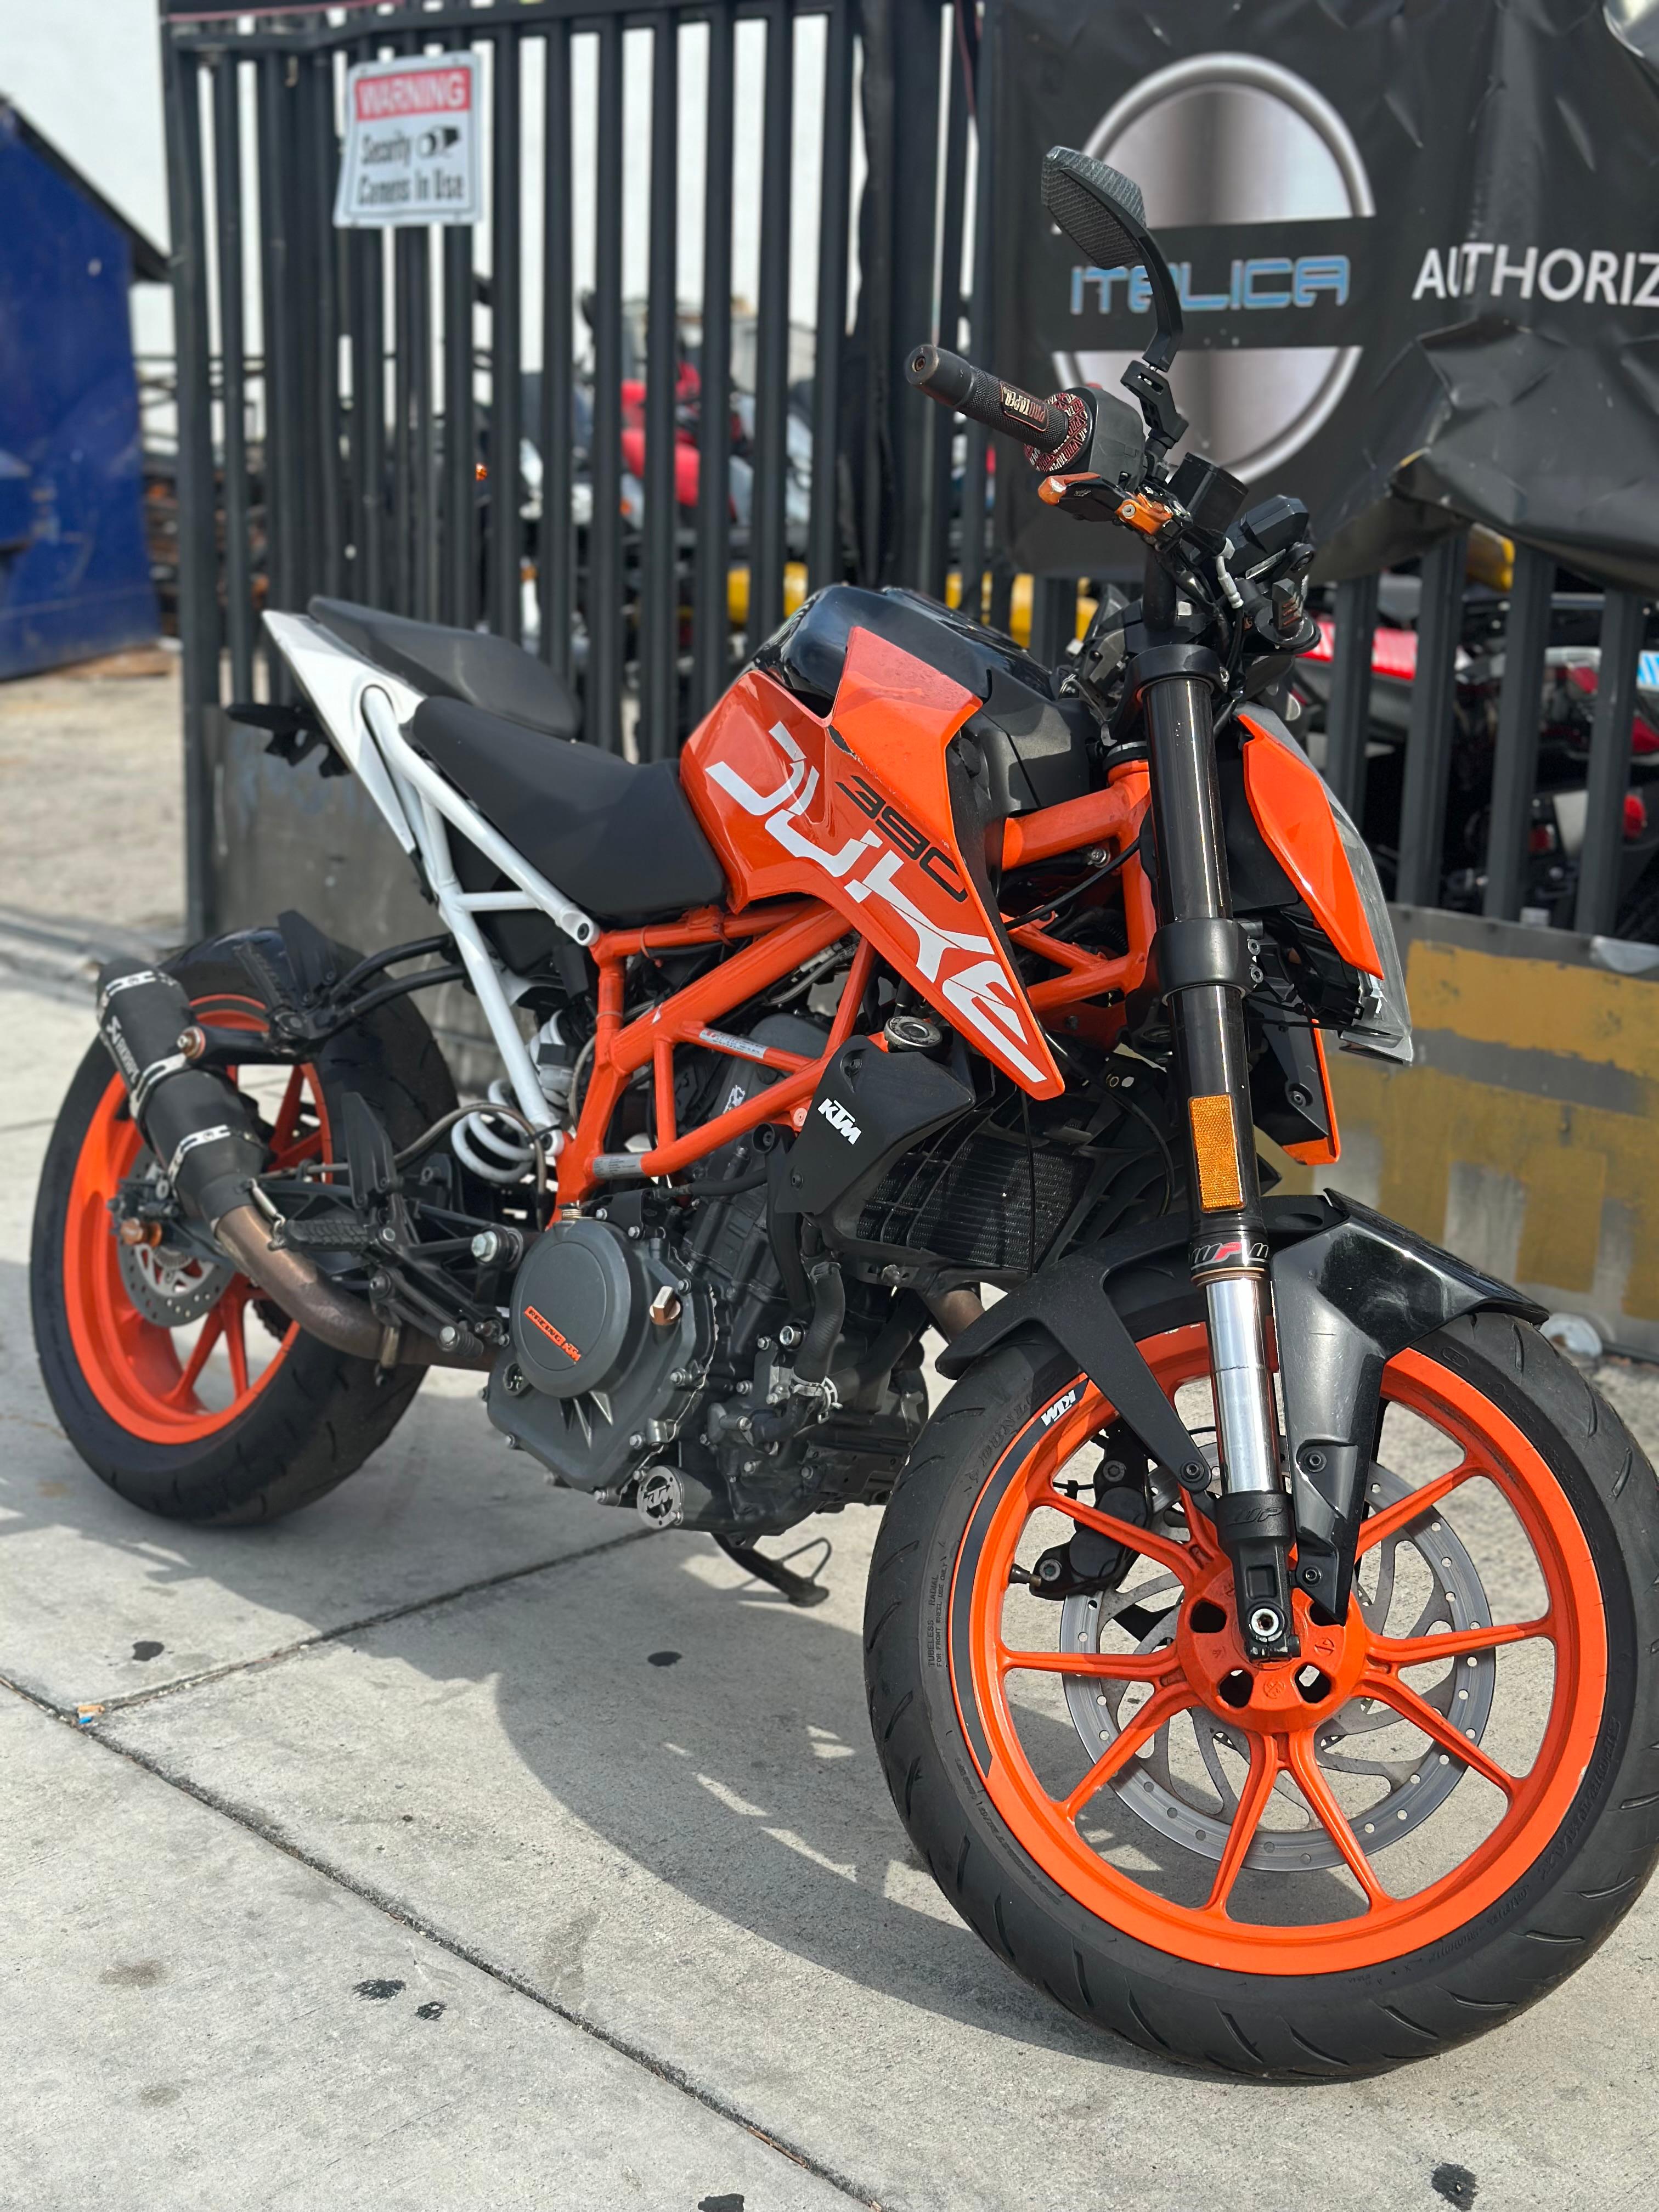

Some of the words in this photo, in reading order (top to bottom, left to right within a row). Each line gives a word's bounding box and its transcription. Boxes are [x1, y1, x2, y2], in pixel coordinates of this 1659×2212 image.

[357, 71, 466, 115] WARNING
[361, 130, 410, 168] Security
[415, 168, 429, 200] In
[435, 167, 464, 201] Use
[836, 775, 968, 903] 390
[817, 1098, 862, 1145] KTM
[527, 1308, 563, 1343] RACING
[561, 1342, 582, 1362] KTM
[1041, 1389, 1076, 1426] KTM
[643, 1483, 673, 1511] KTM
[928, 1574, 939, 1606] RADIAL
